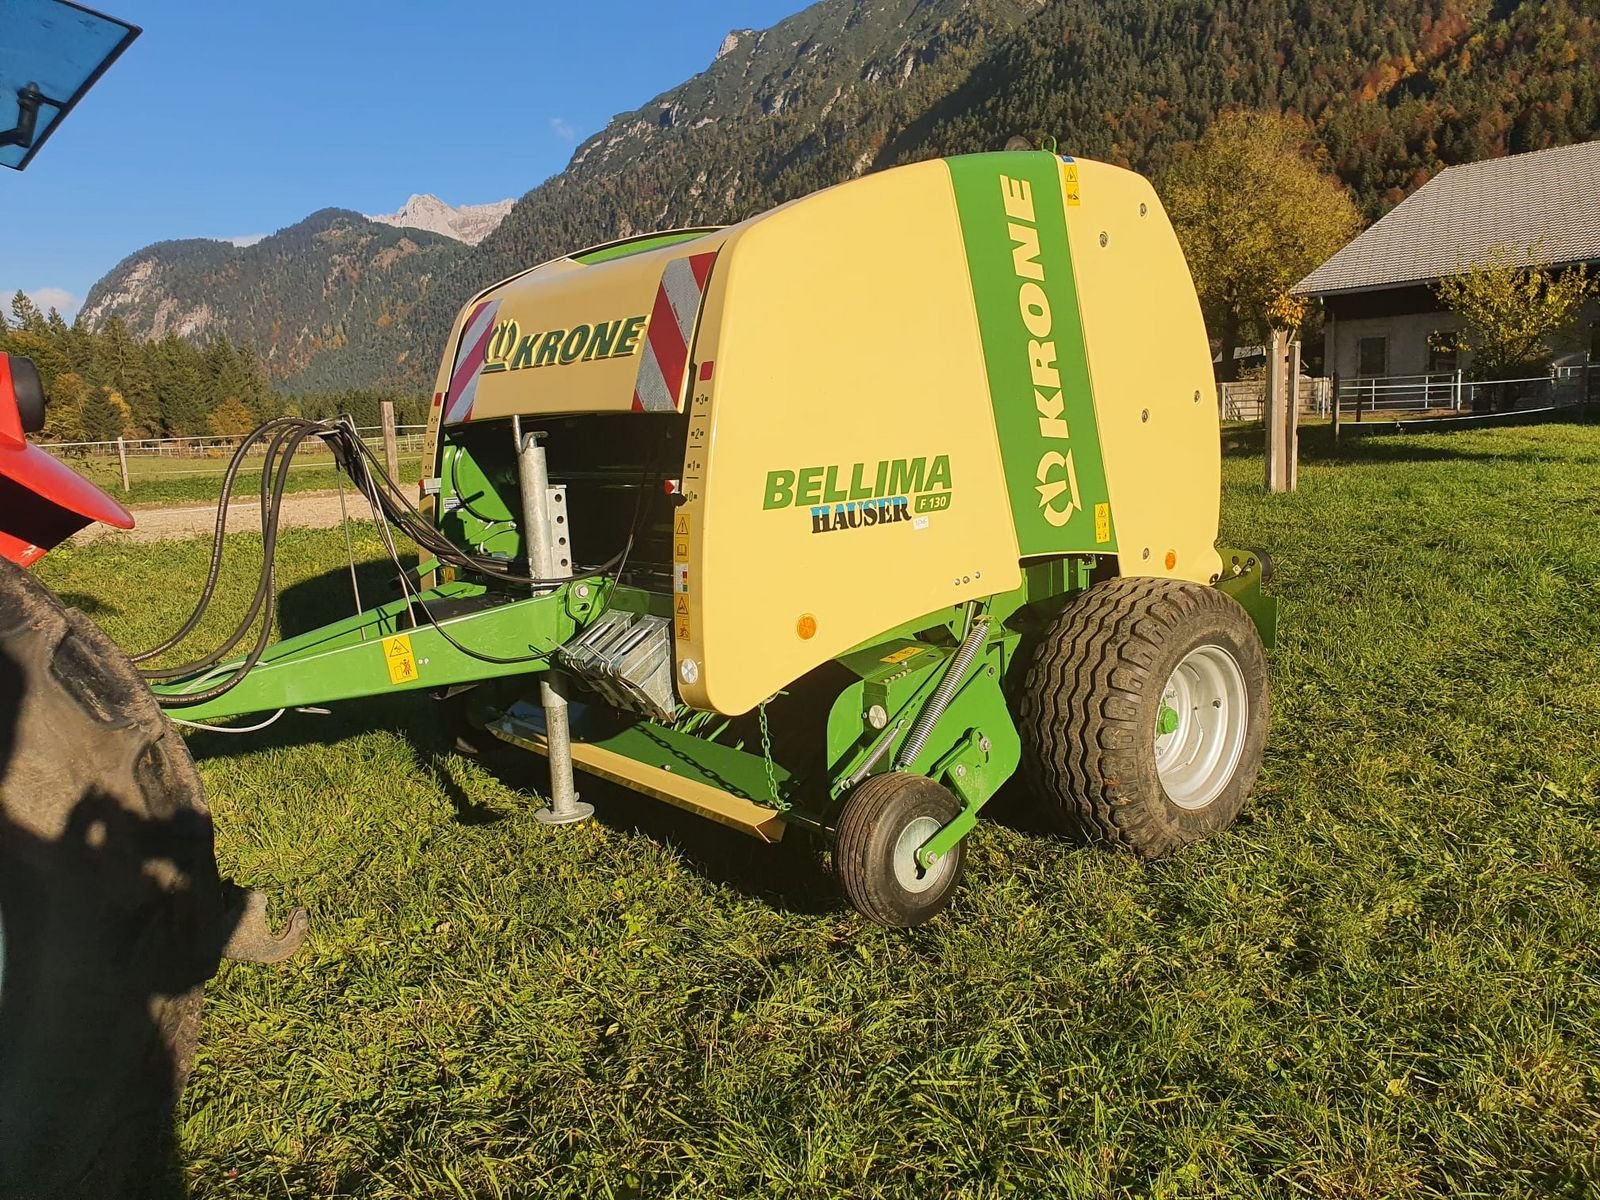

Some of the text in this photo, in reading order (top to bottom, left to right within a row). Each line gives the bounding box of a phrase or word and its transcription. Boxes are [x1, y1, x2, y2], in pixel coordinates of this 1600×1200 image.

[998, 174, 1070, 440] KRONE
[511, 315, 650, 371] KRONE
[762, 454, 953, 511] BELLIMA
[919, 495, 947, 510] F 130
[810, 495, 912, 534] HAUSER
